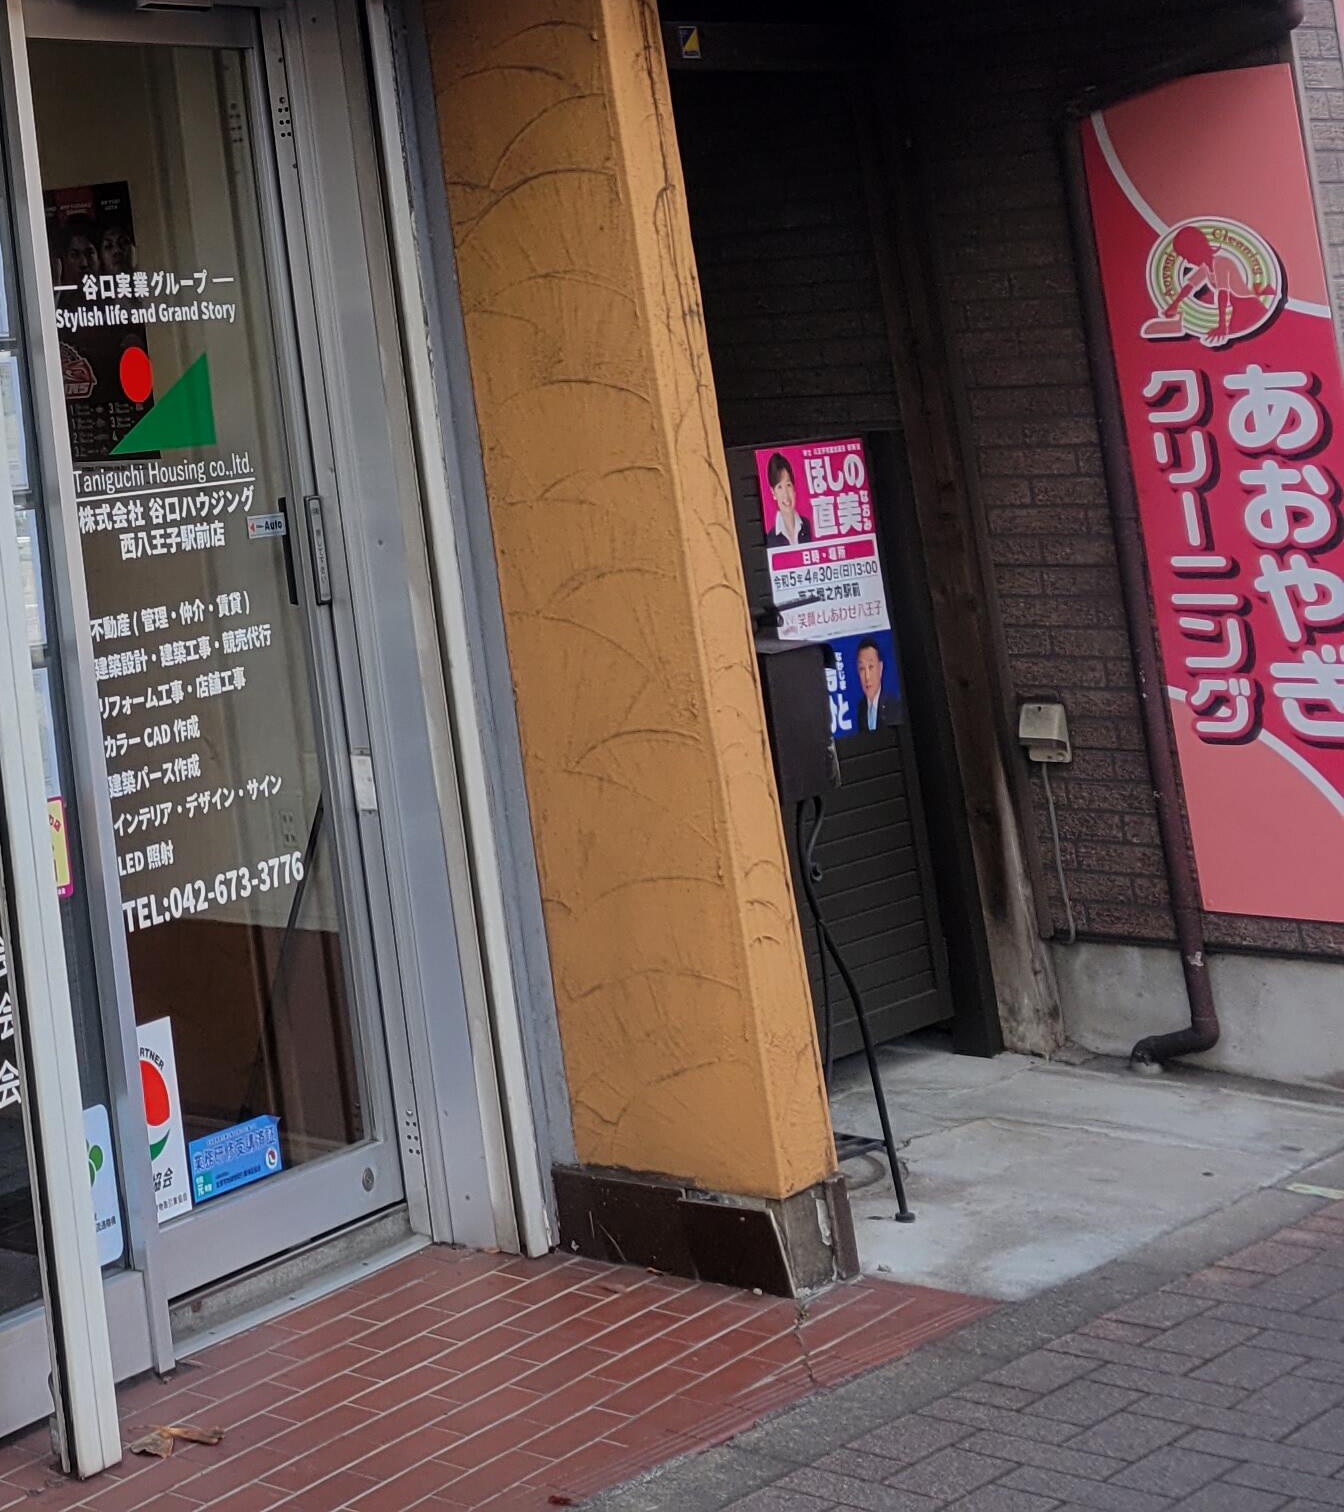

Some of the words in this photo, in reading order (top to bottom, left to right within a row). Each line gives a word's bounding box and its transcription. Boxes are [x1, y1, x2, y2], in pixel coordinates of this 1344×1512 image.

[81, 269, 209, 301] 谷口実業グループ
[55, 306, 104, 334] Stylish
[105, 306, 130, 326] life
[131, 302, 157, 324] and
[158, 300, 200, 324] Grand
[201, 300, 236, 327] Story
[73, 463, 146, 495] Taniguchi
[148, 457, 206, 487] Housing
[208, 451, 255, 479] co.,ltd.
[803, 454, 865, 495] ほしの
[78, 499, 145, 535] 株式会社
[148, 486, 255, 524] 谷口ハウジング
[810, 492, 863, 538] 直美
[120, 520, 226, 561] 西八王子駅前店
[1142, 367, 1256, 744] クリーニング
[1224, 364, 1344, 740] あおやぎ
[98, 666, 247, 720] リフォーム工事・店舗工事
[104, 733, 141, 759] カラー
[143, 723, 172, 748] CAD
[173, 714, 201, 742] 作成
[108, 753, 202, 799] 建築パース作成
[113, 775, 283, 837] インテリア・デザイン・サイン
[118, 851, 145, 877] LED
[147, 839, 175, 871] 照射
[122, 851, 305, 933] TEL:042-673-3776
[139, 1047, 165, 1071] RTNER
